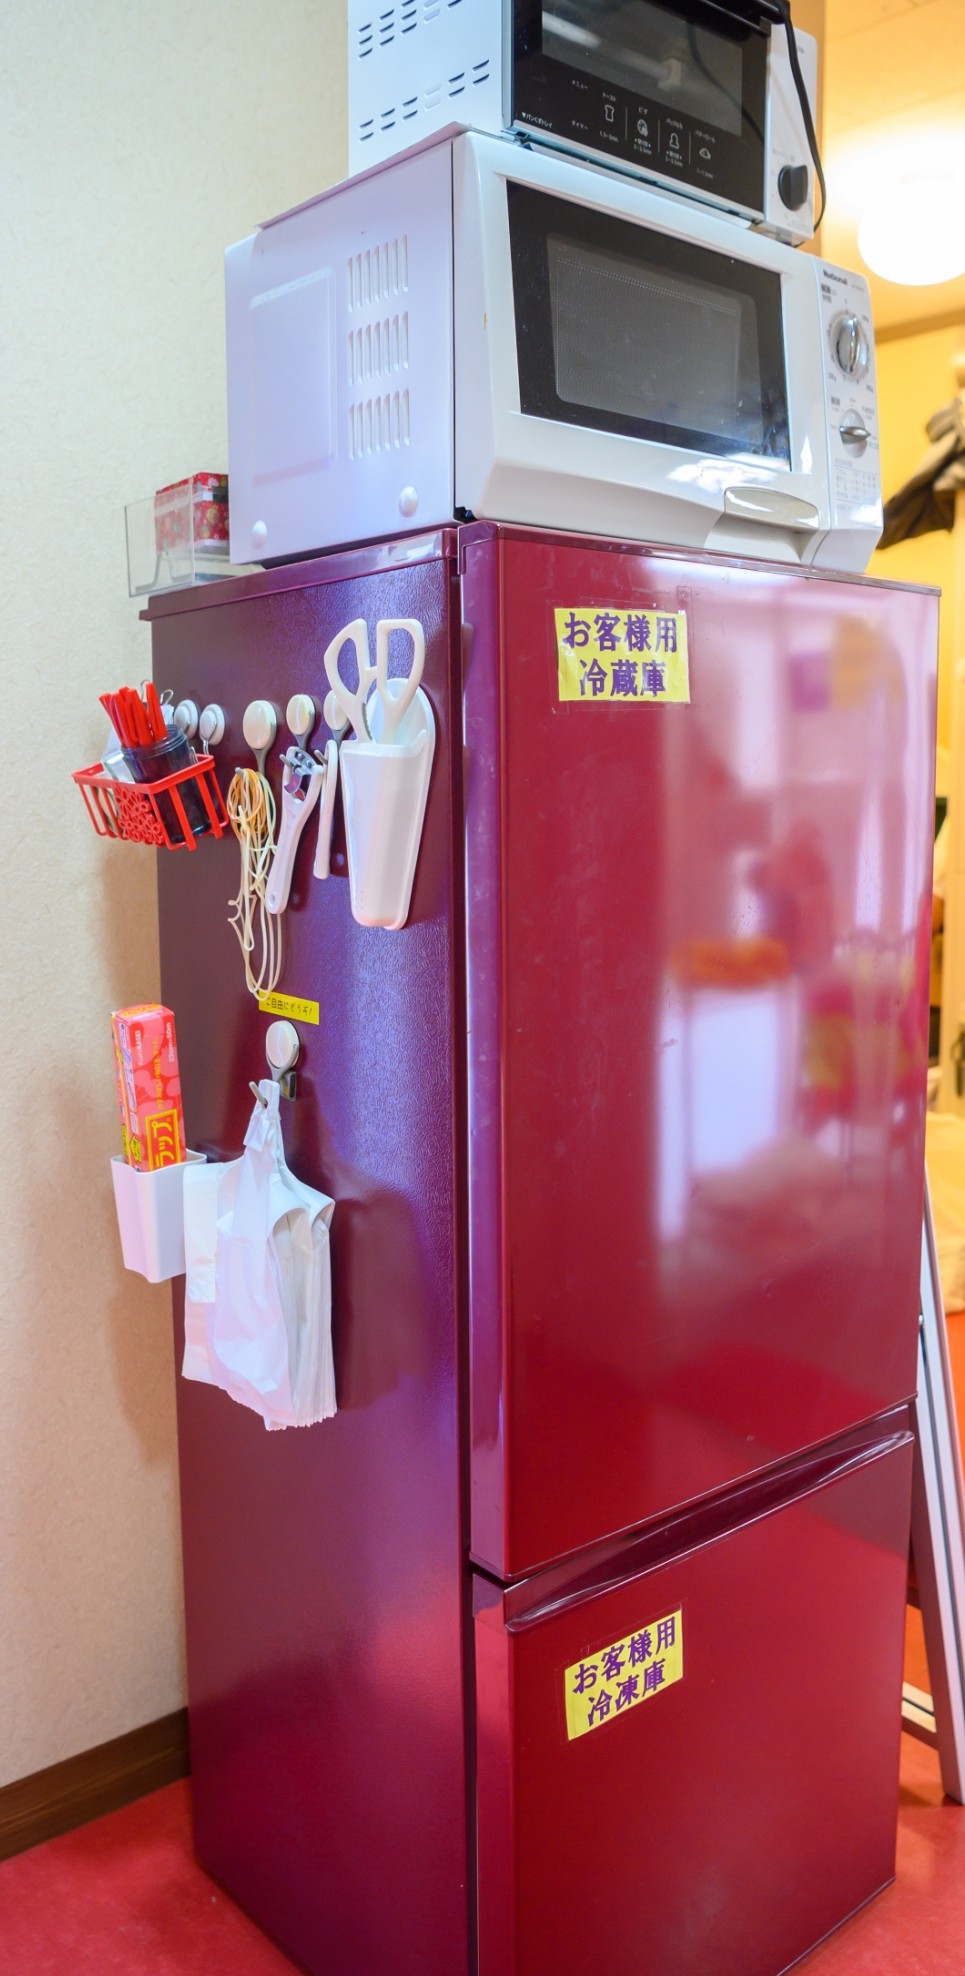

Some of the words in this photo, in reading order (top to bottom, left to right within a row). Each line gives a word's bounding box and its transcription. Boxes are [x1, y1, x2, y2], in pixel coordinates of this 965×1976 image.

[562, 611, 678, 653] お客様用
[579, 657, 667, 697] 冷蔵庫
[572, 1615, 676, 1695] お客様用
[587, 1657, 666, 1727] 冷凍庫
